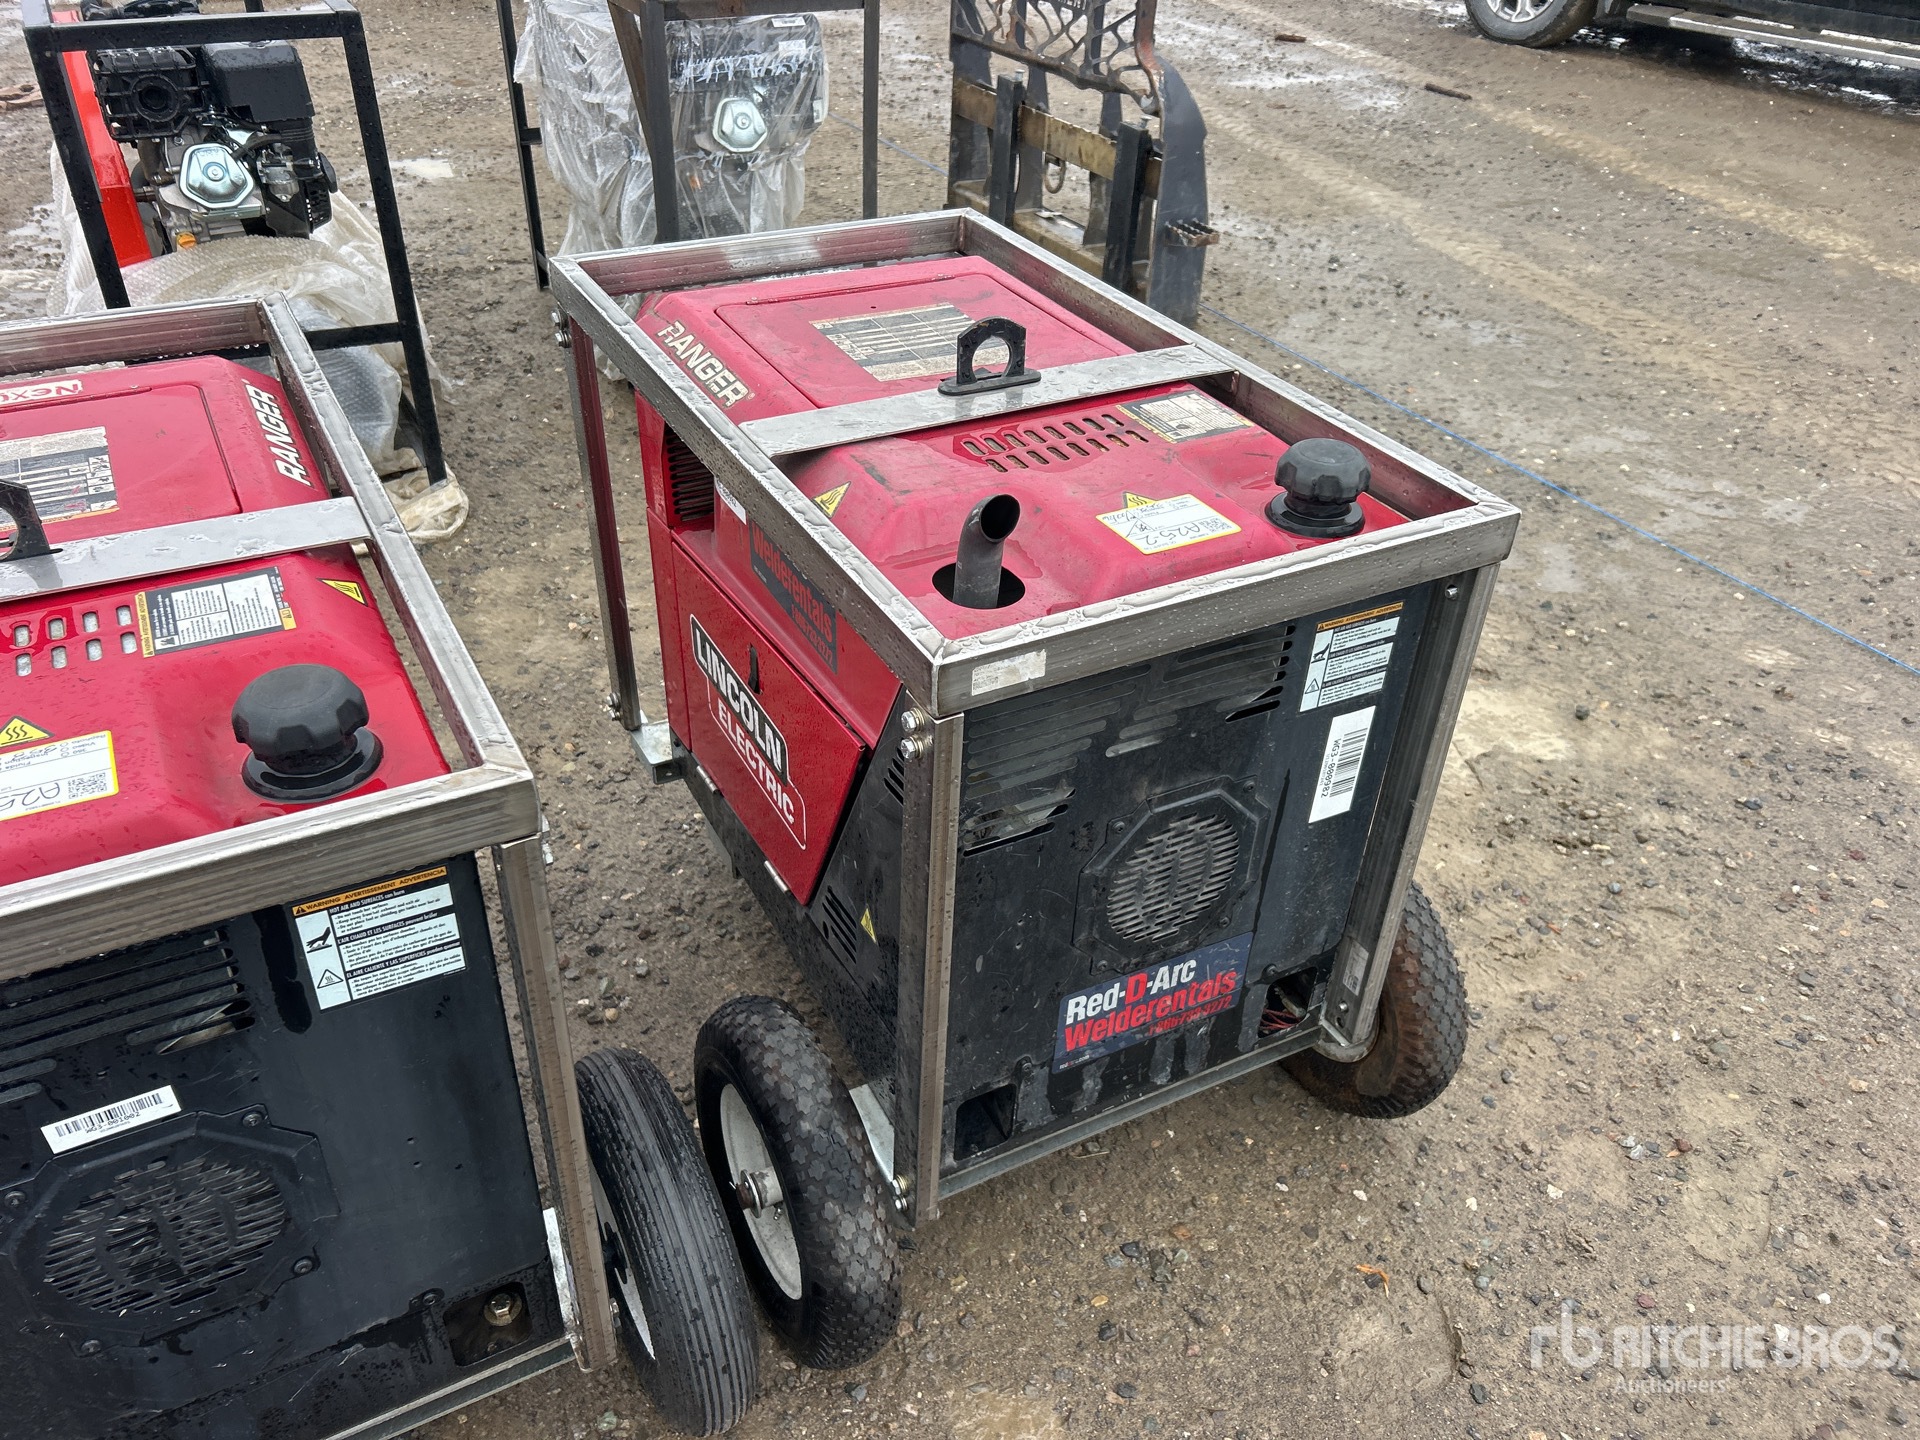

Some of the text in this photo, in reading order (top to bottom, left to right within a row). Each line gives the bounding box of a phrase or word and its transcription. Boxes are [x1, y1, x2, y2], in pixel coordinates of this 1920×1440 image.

[657, 320, 750, 407] RANGER
[245, 385, 312, 486] RANGER
[753, 521, 833, 644] Welderentals
[696, 627, 783, 773] LINCOLN
[718, 696, 795, 825] ELECTRIC
[1320, 737, 1342, 798] WG3-000982
[305, 868, 444, 910] WARNING AVERTISSEMENT ADVERTENCIA
[1065, 969, 1238, 1052] Welderentals
[1066, 959, 1197, 1025] Red-D-Arc
